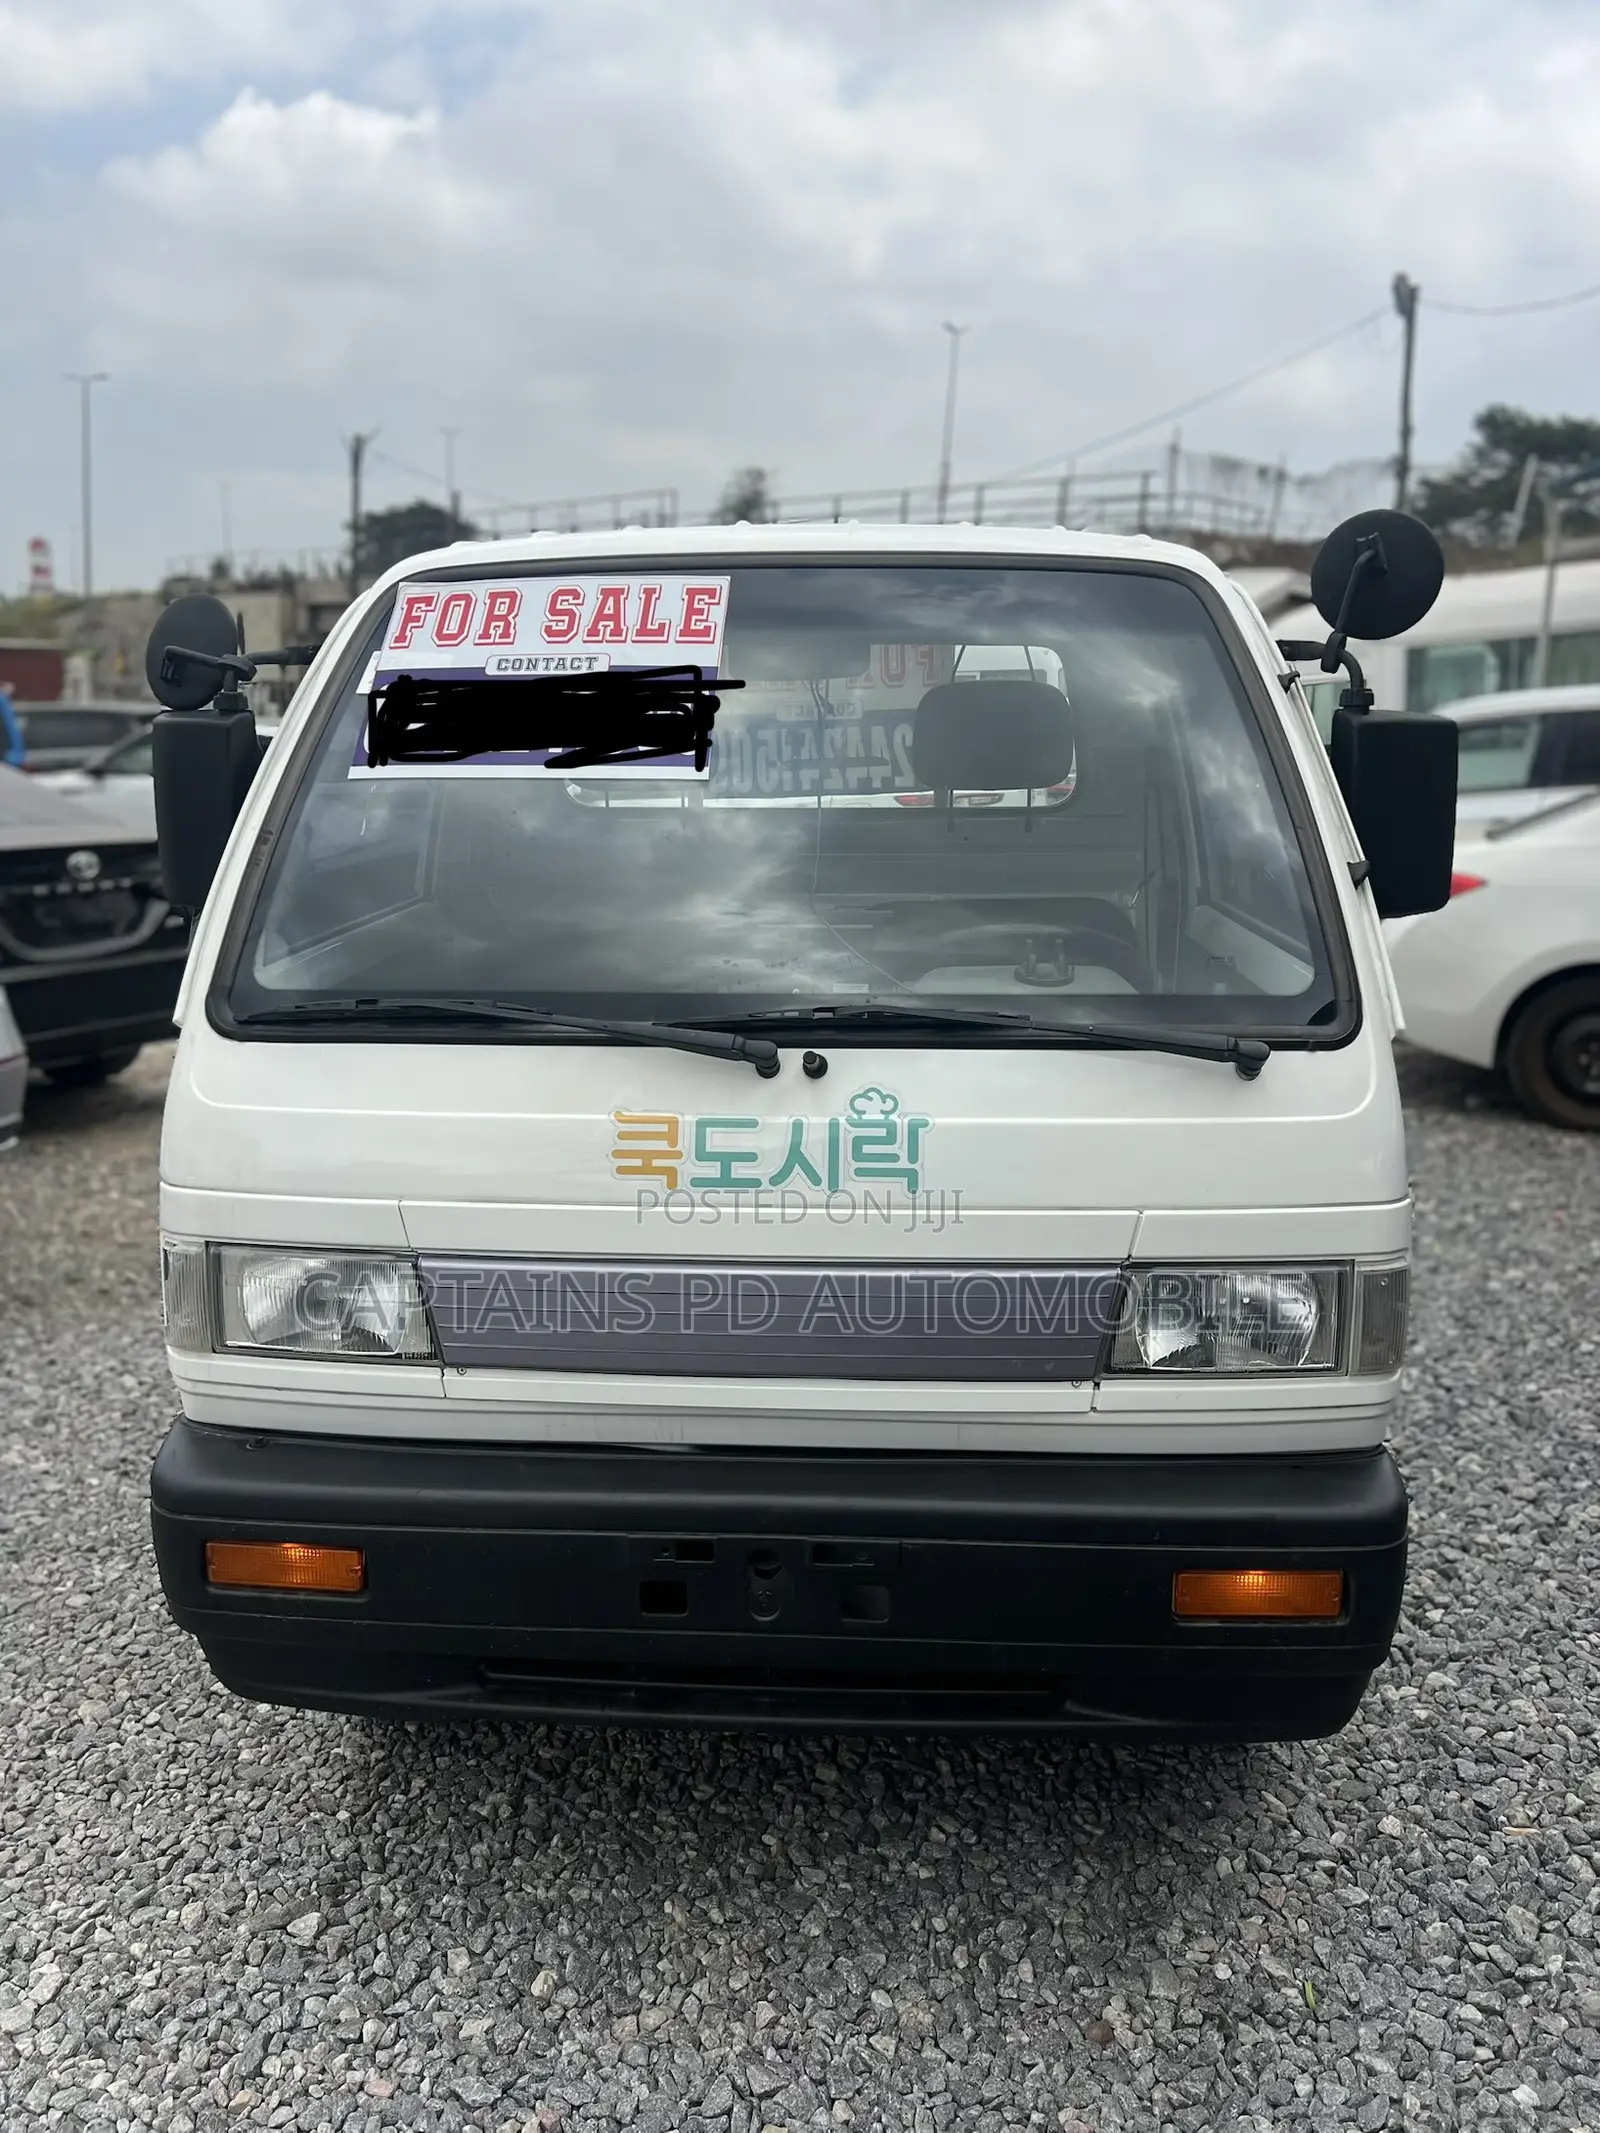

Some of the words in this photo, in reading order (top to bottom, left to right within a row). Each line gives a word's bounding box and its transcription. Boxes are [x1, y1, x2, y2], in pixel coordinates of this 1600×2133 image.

[389, 587, 522, 648] FOR
[541, 584, 722, 644] SALE
[497, 656, 599, 672] CONTACT
[611, 1107, 930, 1195] 쿡도시락
